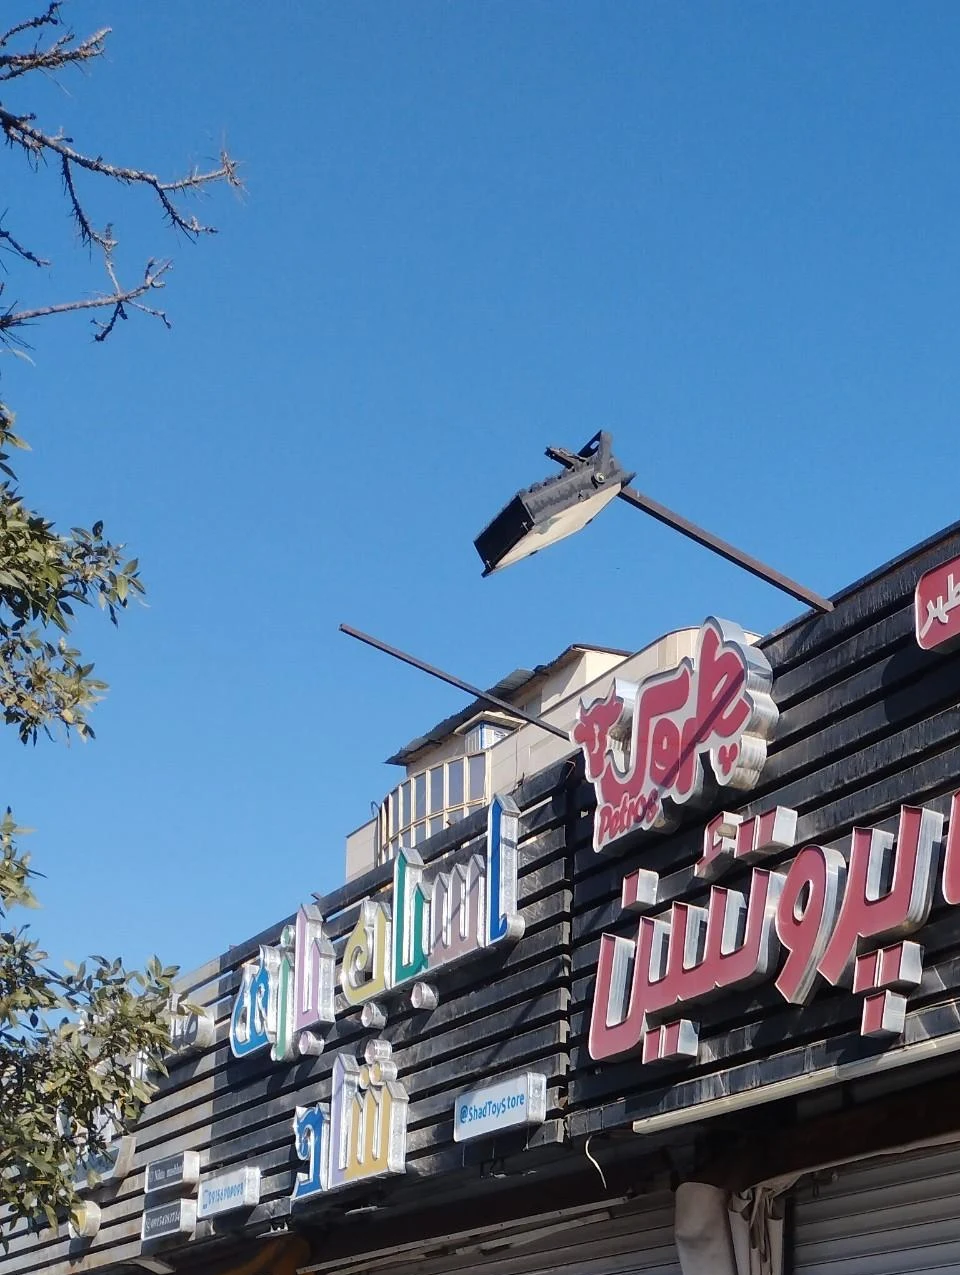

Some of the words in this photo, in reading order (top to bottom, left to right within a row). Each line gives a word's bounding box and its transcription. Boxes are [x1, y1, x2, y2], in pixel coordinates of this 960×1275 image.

[230, 903, 335, 1062] بازی
[341, 793, 524, 1028] اسباب
[588, 804, 942, 1064] پروتئین
[290, 1040, 409, 1200] شاد
[460, 1093, 525, 1124] @ShadToyStore
